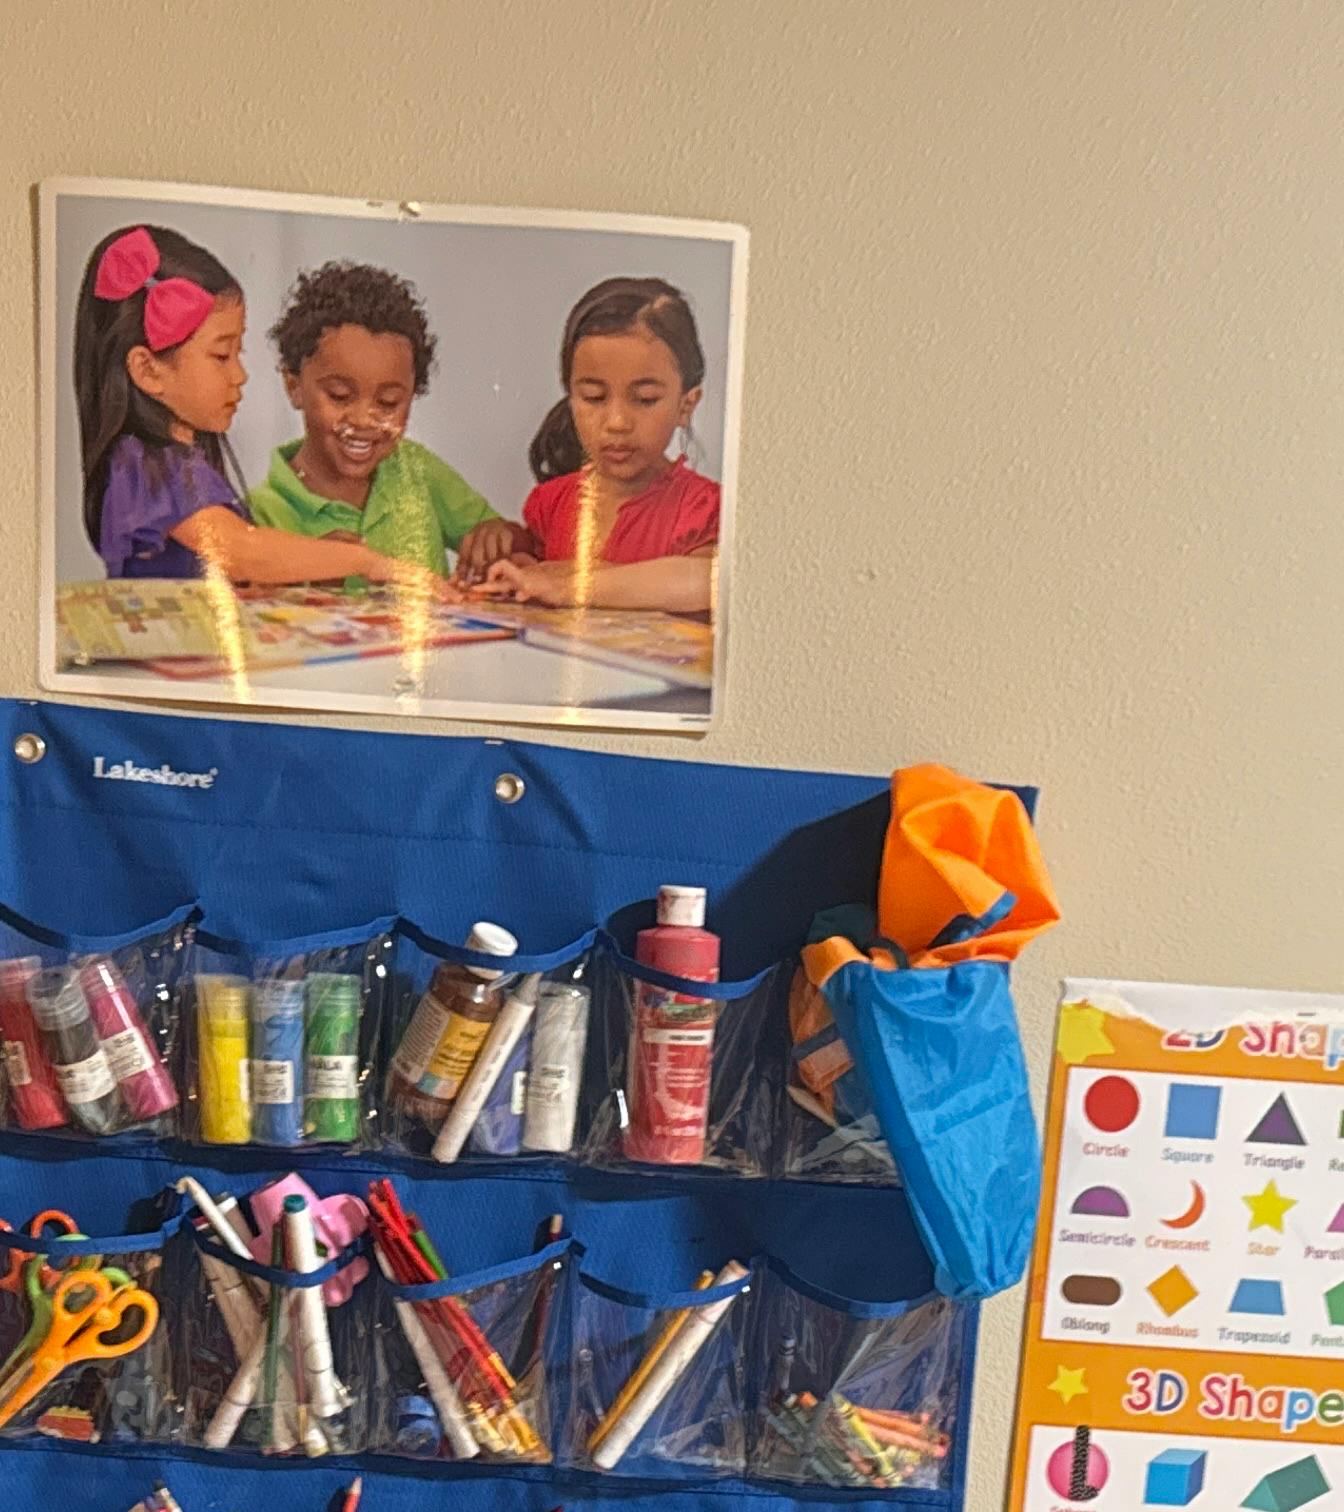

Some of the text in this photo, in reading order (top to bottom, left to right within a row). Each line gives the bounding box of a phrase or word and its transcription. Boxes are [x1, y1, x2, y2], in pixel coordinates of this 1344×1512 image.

[1082, 1142, 1128, 1158] Circle
[1161, 1148, 1214, 1164] Square
[1243, 1153, 1305, 1171] Triangle
[1058, 1229, 1136, 1248] Semicircle
[1144, 1235, 1211, 1252] Crescent
[1218, 1327, 1292, 1345] Trapezoid
[1126, 1371, 1187, 1413] 3D
